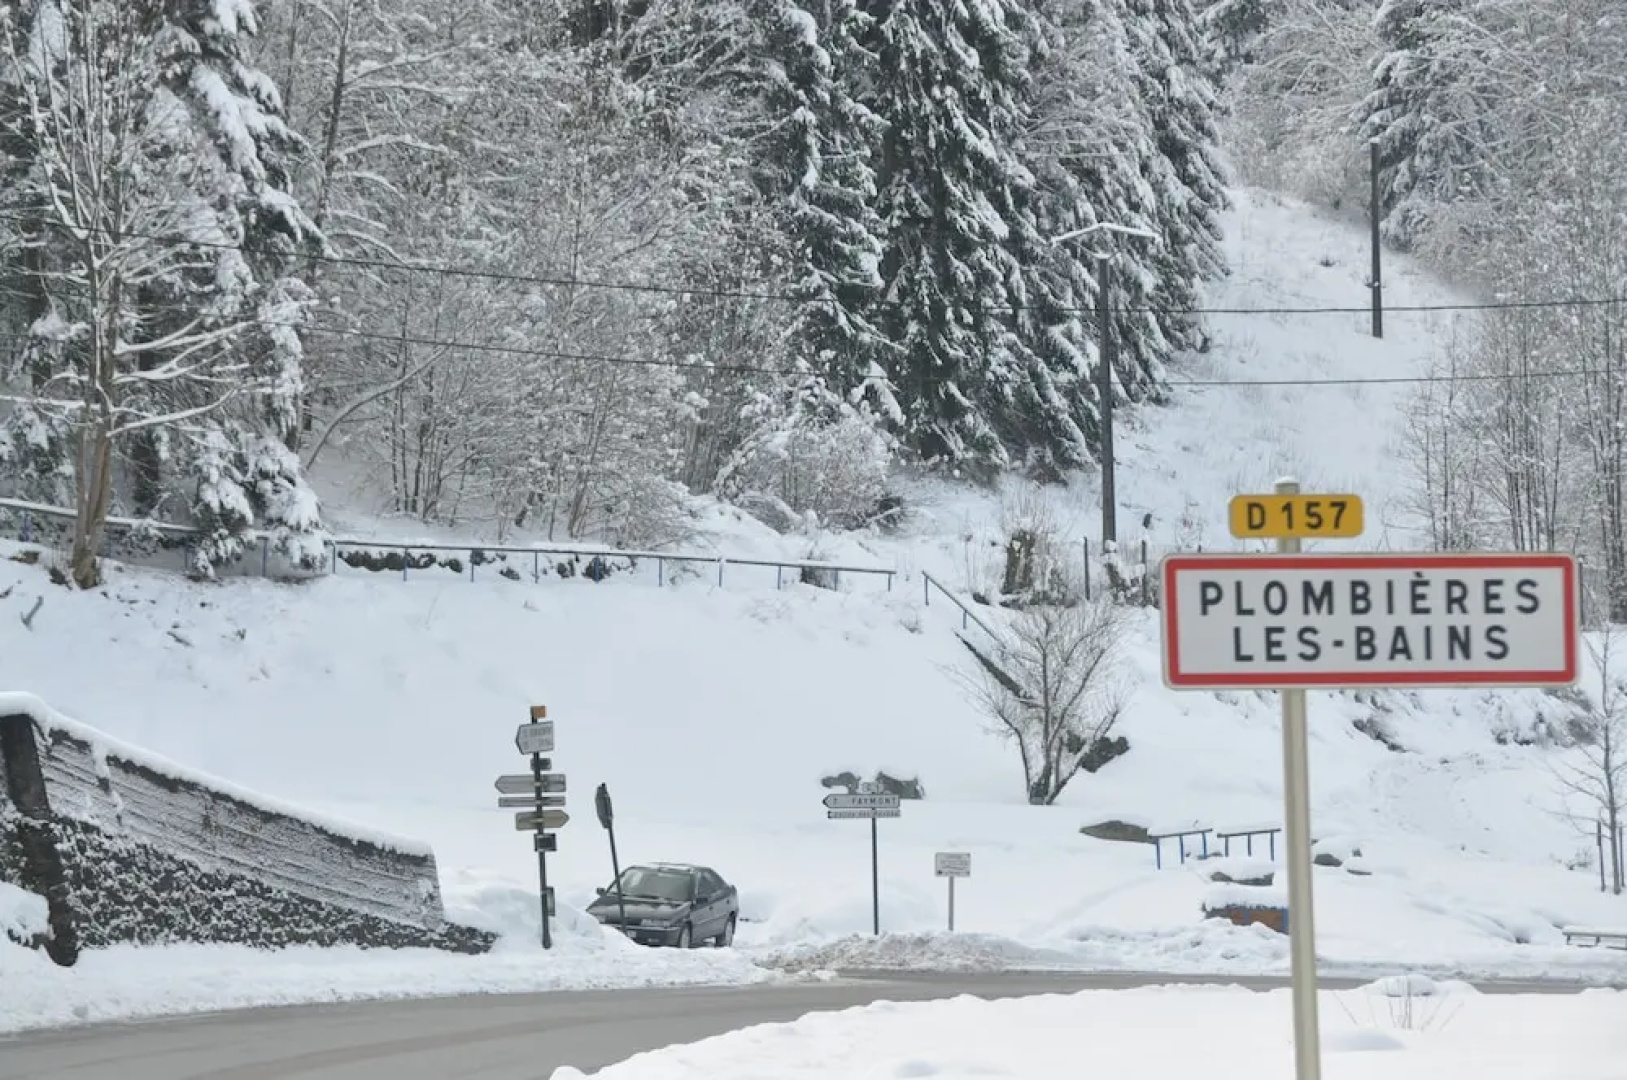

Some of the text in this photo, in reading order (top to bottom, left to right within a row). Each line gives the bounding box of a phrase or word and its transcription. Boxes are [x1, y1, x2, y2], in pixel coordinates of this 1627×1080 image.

[1247, 501, 1348, 530] D 157
[1200, 571, 1541, 616] PLOMBIÈRES
[1233, 625, 1510, 662] LES-BAINS
[852, 796, 896, 806] FAYMONT
